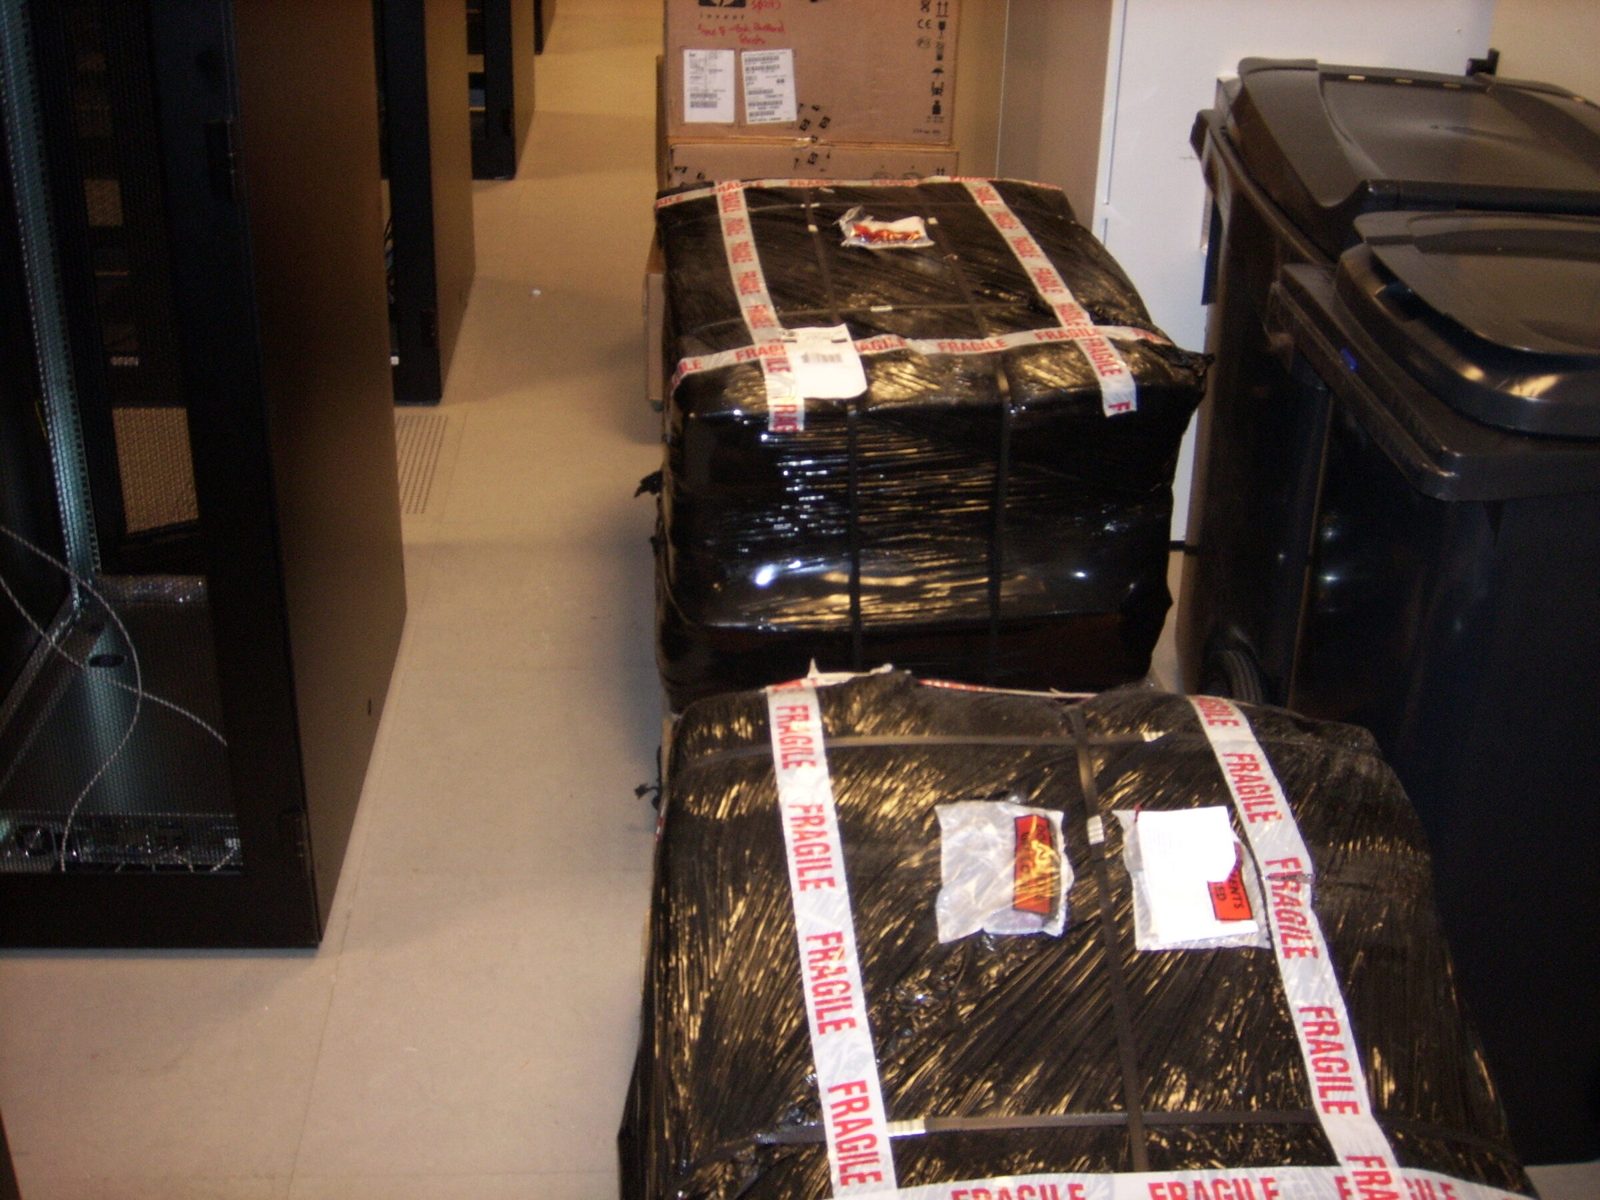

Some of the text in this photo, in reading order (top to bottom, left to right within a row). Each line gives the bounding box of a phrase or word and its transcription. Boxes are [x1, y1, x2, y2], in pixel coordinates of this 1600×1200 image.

[776, 704, 817, 770] FRAGILE
[1222, 753, 1283, 824] FRAGILE
[788, 803, 836, 893] FRAGILE
[1265, 857, 1319, 960] FRAGILE
[804, 931, 857, 1035] FRAGILE
[1298, 1006, 1360, 1115] FRAGILE
[828, 1080, 884, 1186] FRAGILE
